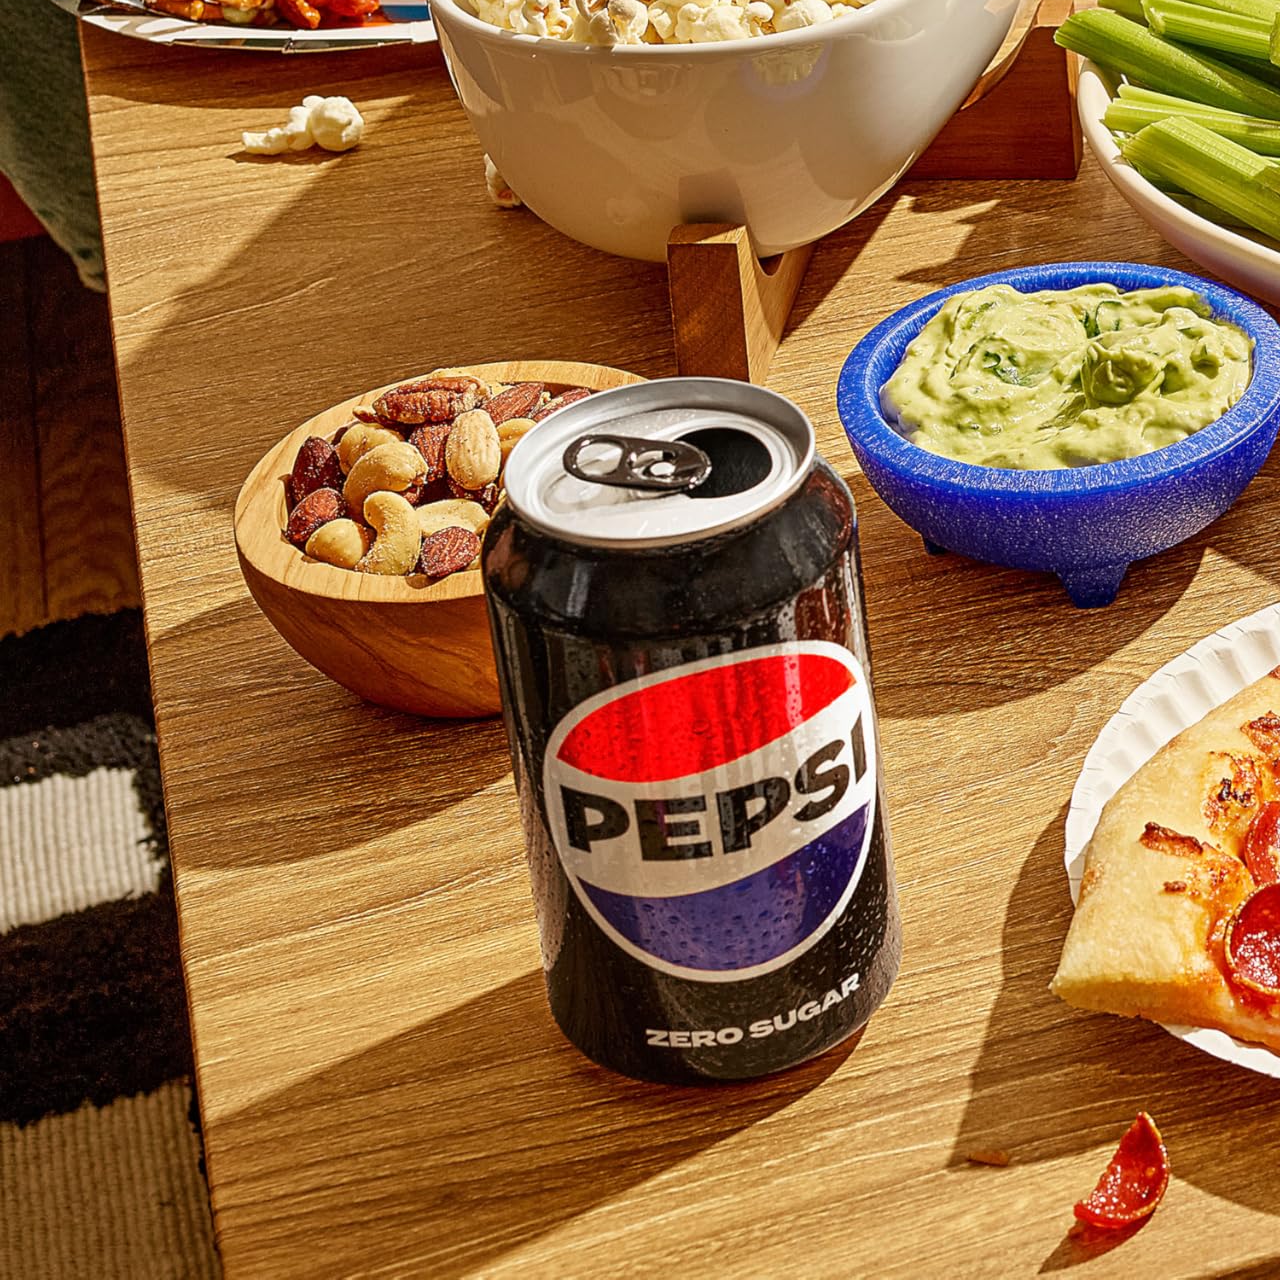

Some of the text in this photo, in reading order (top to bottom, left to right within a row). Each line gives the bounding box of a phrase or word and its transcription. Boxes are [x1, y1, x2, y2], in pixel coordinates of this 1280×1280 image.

[560, 711, 867, 862] PEPSI
[646, 973, 861, 1048] ZERO SUGAR
